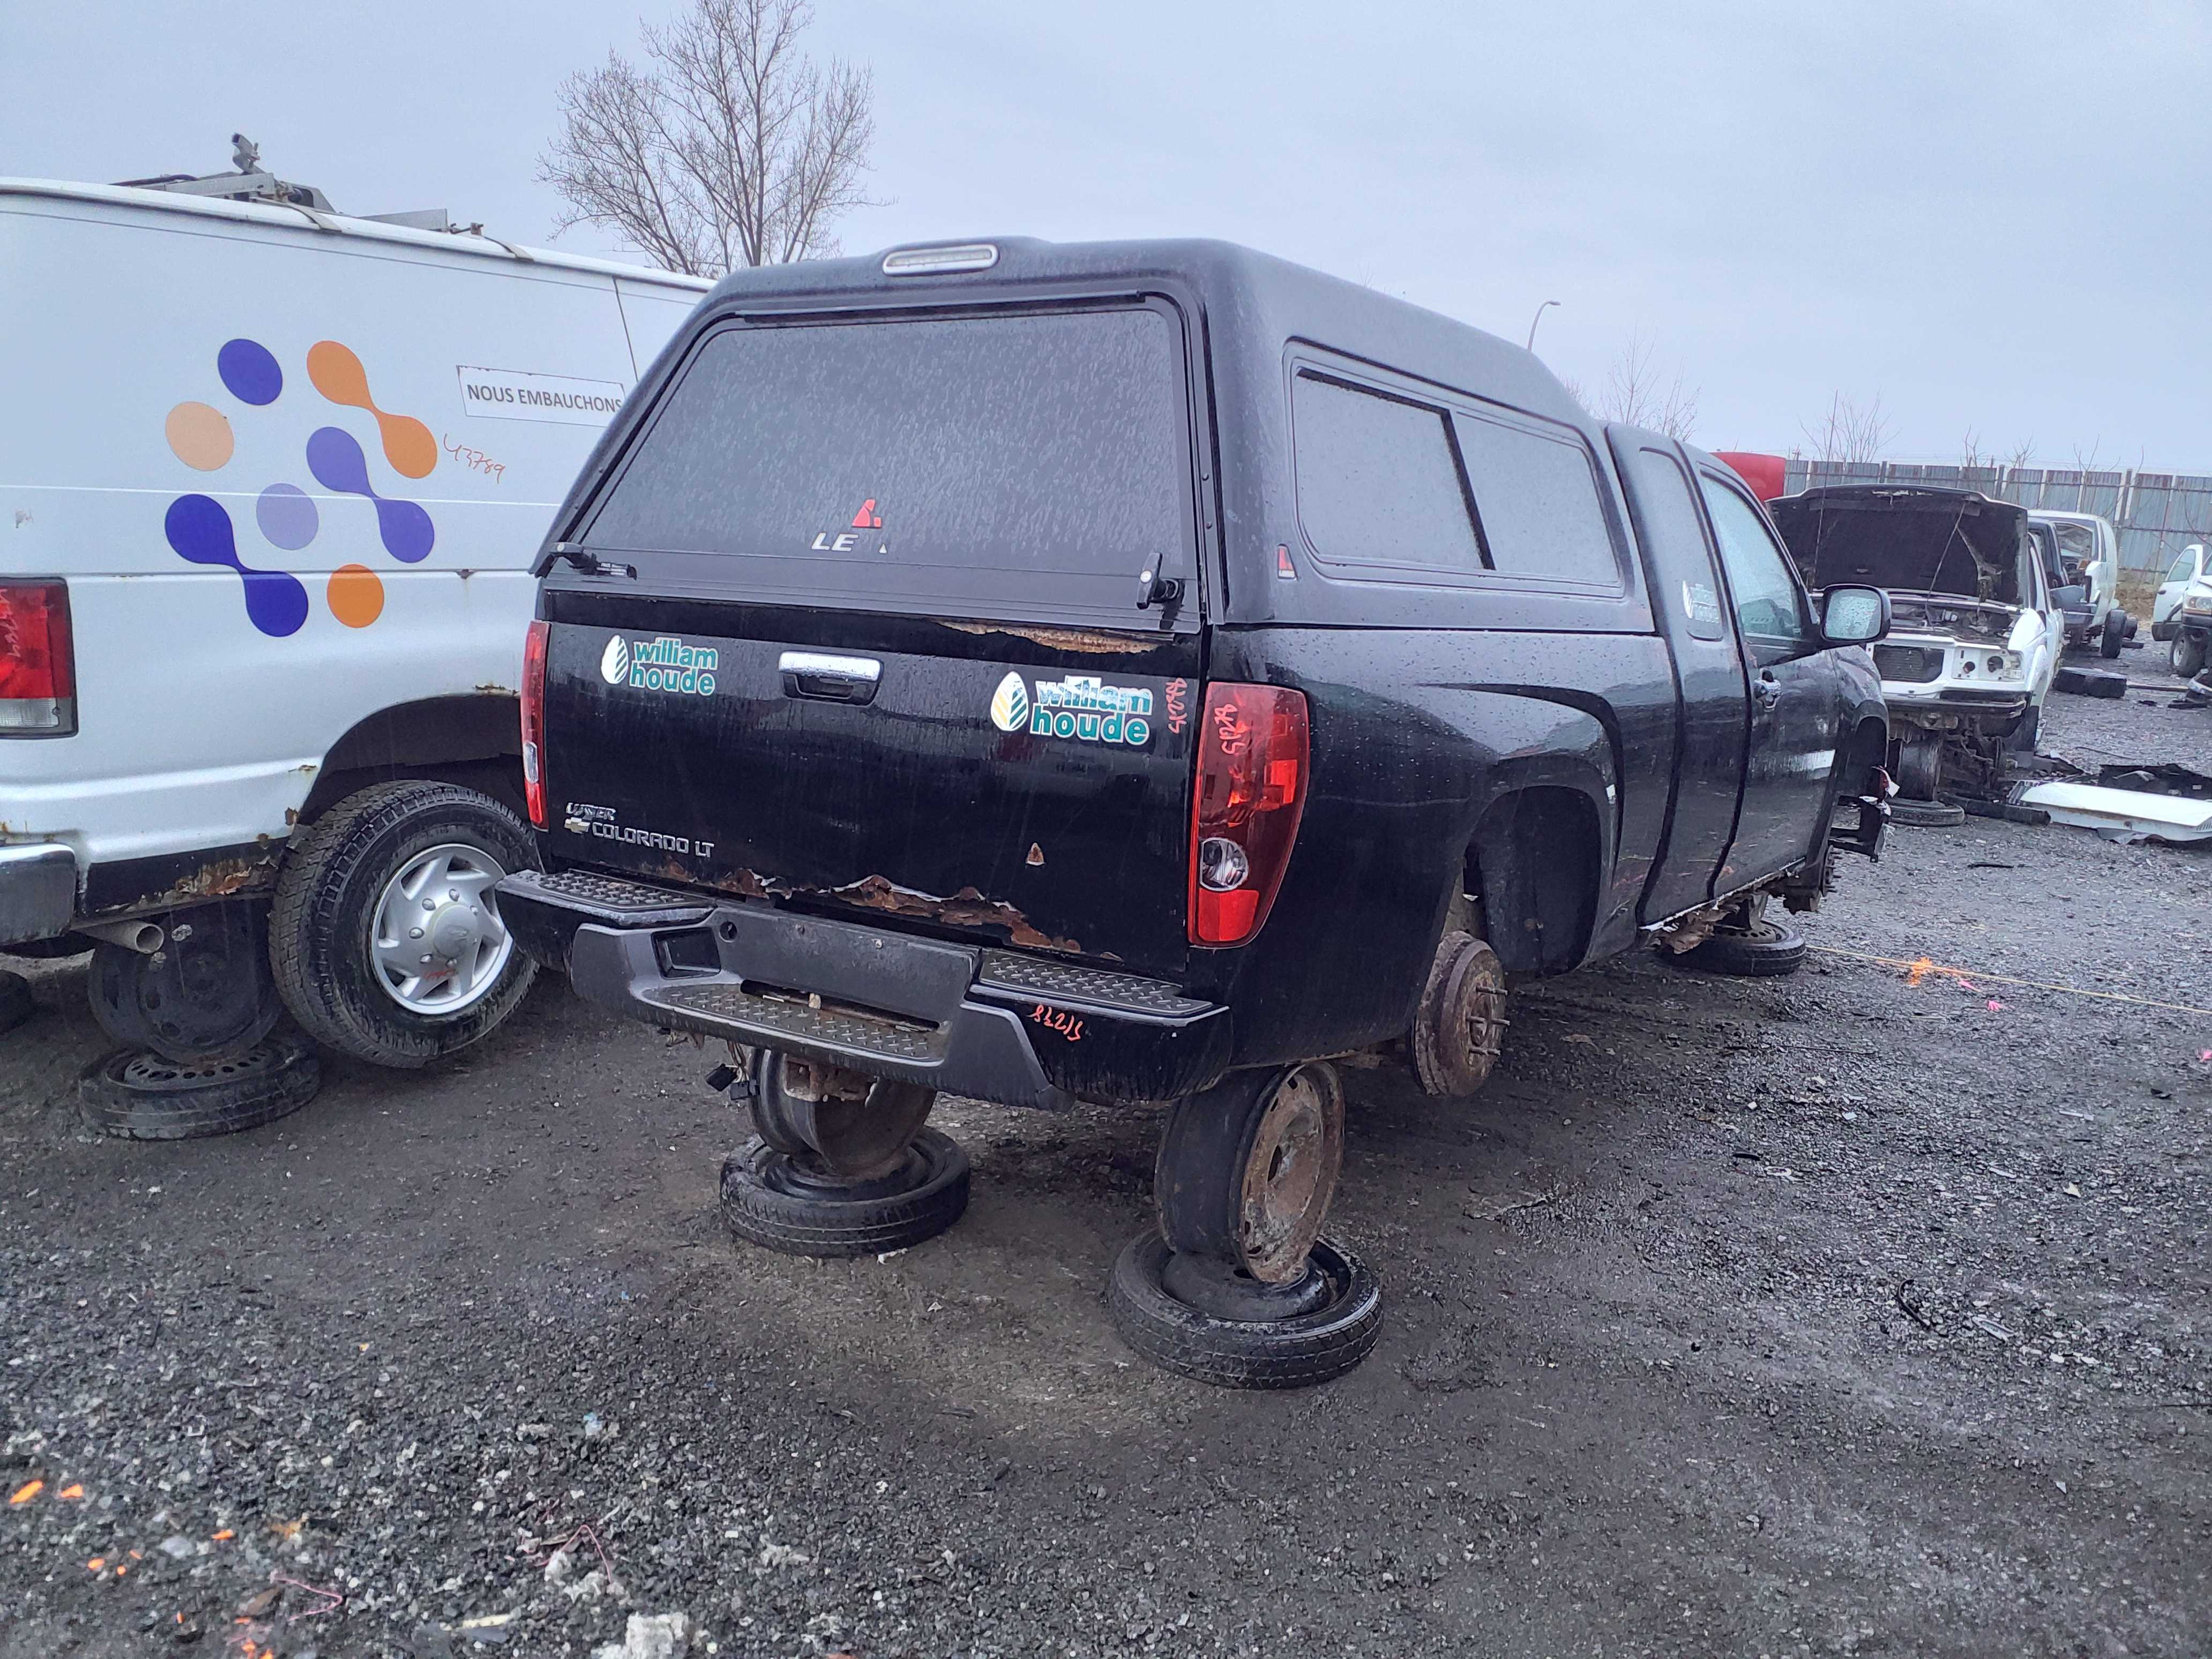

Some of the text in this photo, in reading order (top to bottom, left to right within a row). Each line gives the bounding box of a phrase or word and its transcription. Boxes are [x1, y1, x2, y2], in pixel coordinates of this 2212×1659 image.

[467, 384, 622, 413] NOUS EMBAUCHONS
[443, 433, 506, 484] 43789
[633, 637, 719, 670] william
[629, 660, 715, 697] houde
[1035, 675, 1154, 715] william
[1029, 703, 1150, 745] houde
[592, 821, 715, 858] COLORADO LT
